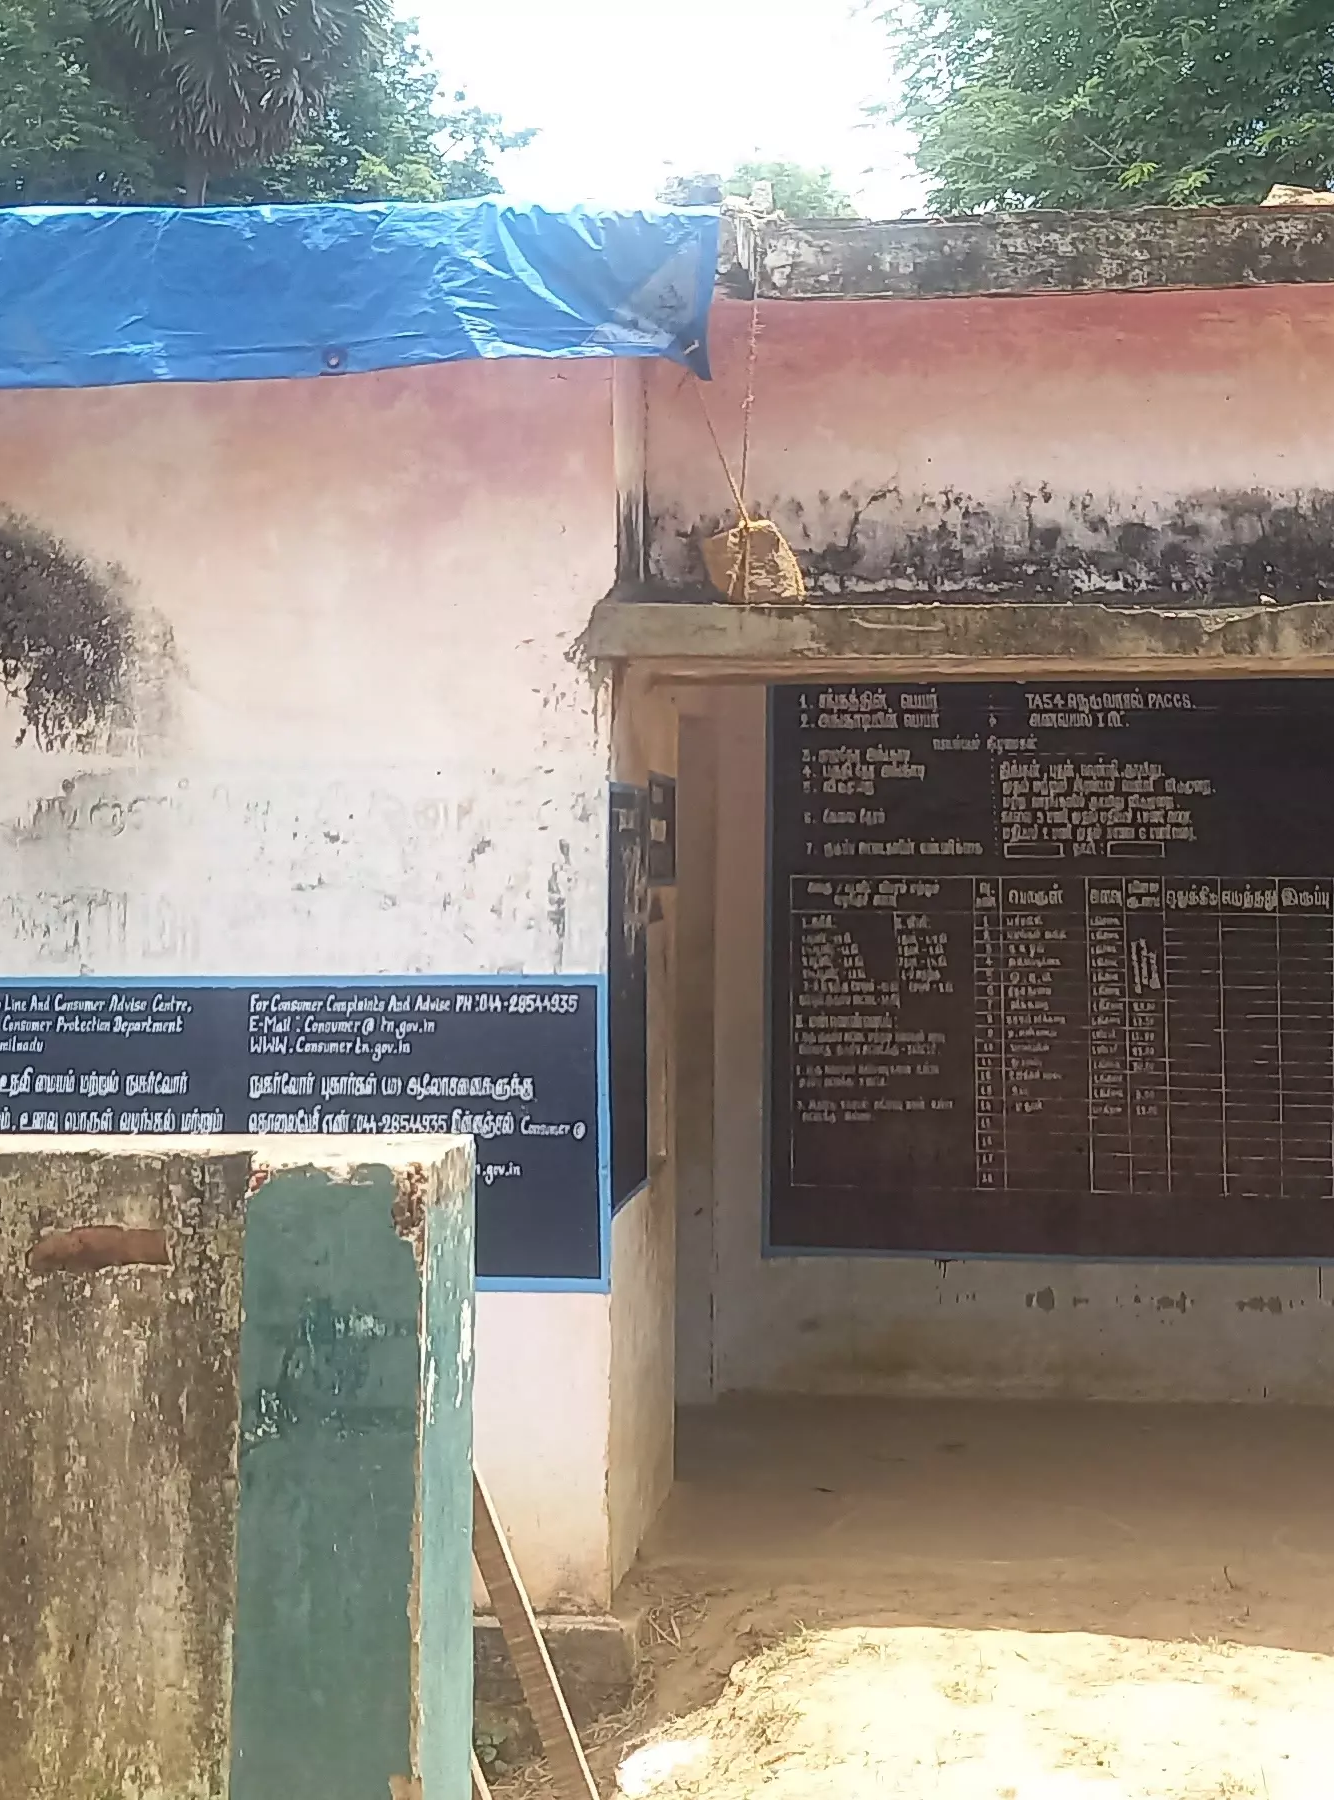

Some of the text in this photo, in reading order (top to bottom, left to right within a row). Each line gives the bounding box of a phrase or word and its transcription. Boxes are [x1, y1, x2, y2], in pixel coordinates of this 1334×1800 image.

[4, 993, 27, 1013] Line
[28, 994, 51, 1012] And
[54, 993, 106, 1012] Consumer
[249, 993, 268, 1013] For
[270, 993, 324, 1012] Consumer
[326, 994, 386, 1019] Complaints
[387, 994, 411, 1012] And
[2, 1015, 53, 1032] Consumer
[55, 1015, 111, 1033] Protection
[112, 1015, 183, 1038] Department
[34, 1069, 76, 1094] மையம்
[79, 1069, 120, 1098] மற்றும்
[125, 1070, 189, 1097] நுகர்வோர்
[248, 1071, 316, 1099] நுகர்வோர்
[320, 1071, 378, 1101] புகார்கள்
[19, 1111, 59, 1134] உணவு
[64, 1107, 114, 1134] பொருள்
[119, 1107, 176, 1134] வழங்கல்
[180, 1107, 223, 1134] மற்றும்
[321, 1109, 351, 1134] எண்
